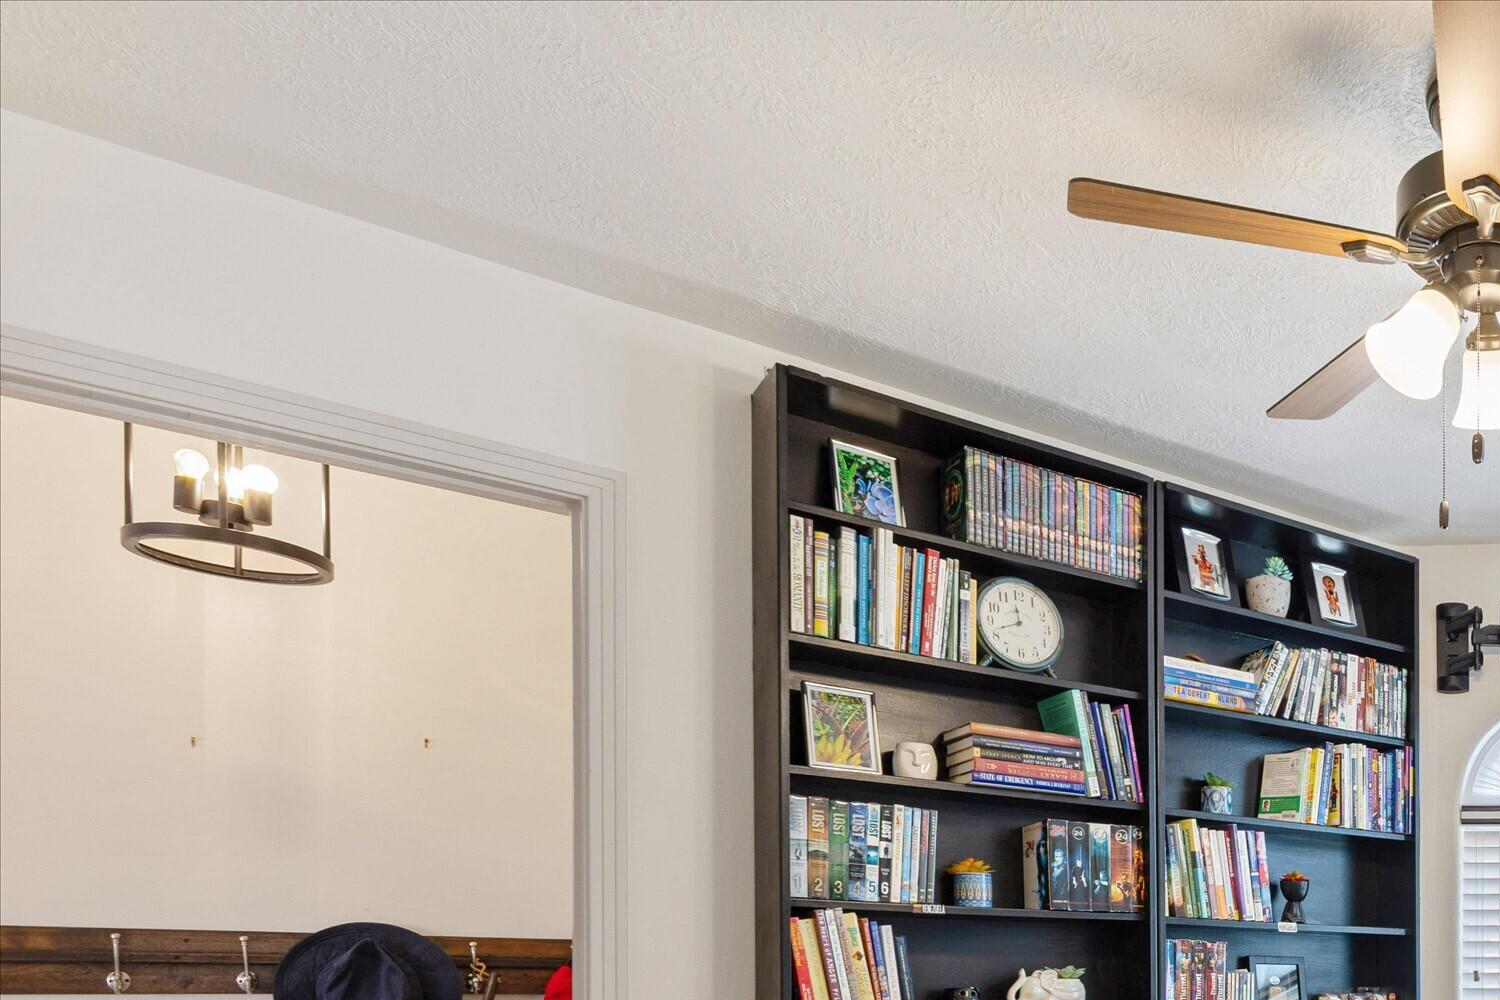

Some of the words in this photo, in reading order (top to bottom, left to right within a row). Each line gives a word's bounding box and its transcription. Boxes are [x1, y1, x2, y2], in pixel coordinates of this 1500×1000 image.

[999, 591, 1008, 603] 11
[1013, 590, 1025, 602] 12
[989, 601, 1000, 614] 10
[980, 773, 995, 781] STATE
[1004, 775, 1034, 785] EMERGENCY
[812, 810, 824, 833] LOST
[833, 813, 845, 836] LOST
[853, 814, 865, 838] LOST
[869, 820, 878, 838] LOST
[882, 820, 891, 839] LOST
[815, 878, 824, 892] 2
[834, 880, 843, 894] 3
[868, 881, 875, 893] 5
[882, 882, 888, 894] 6
[818, 911, 826, 926] The
[825, 948, 832, 957] of
[826, 958, 837, 984] ANGER
